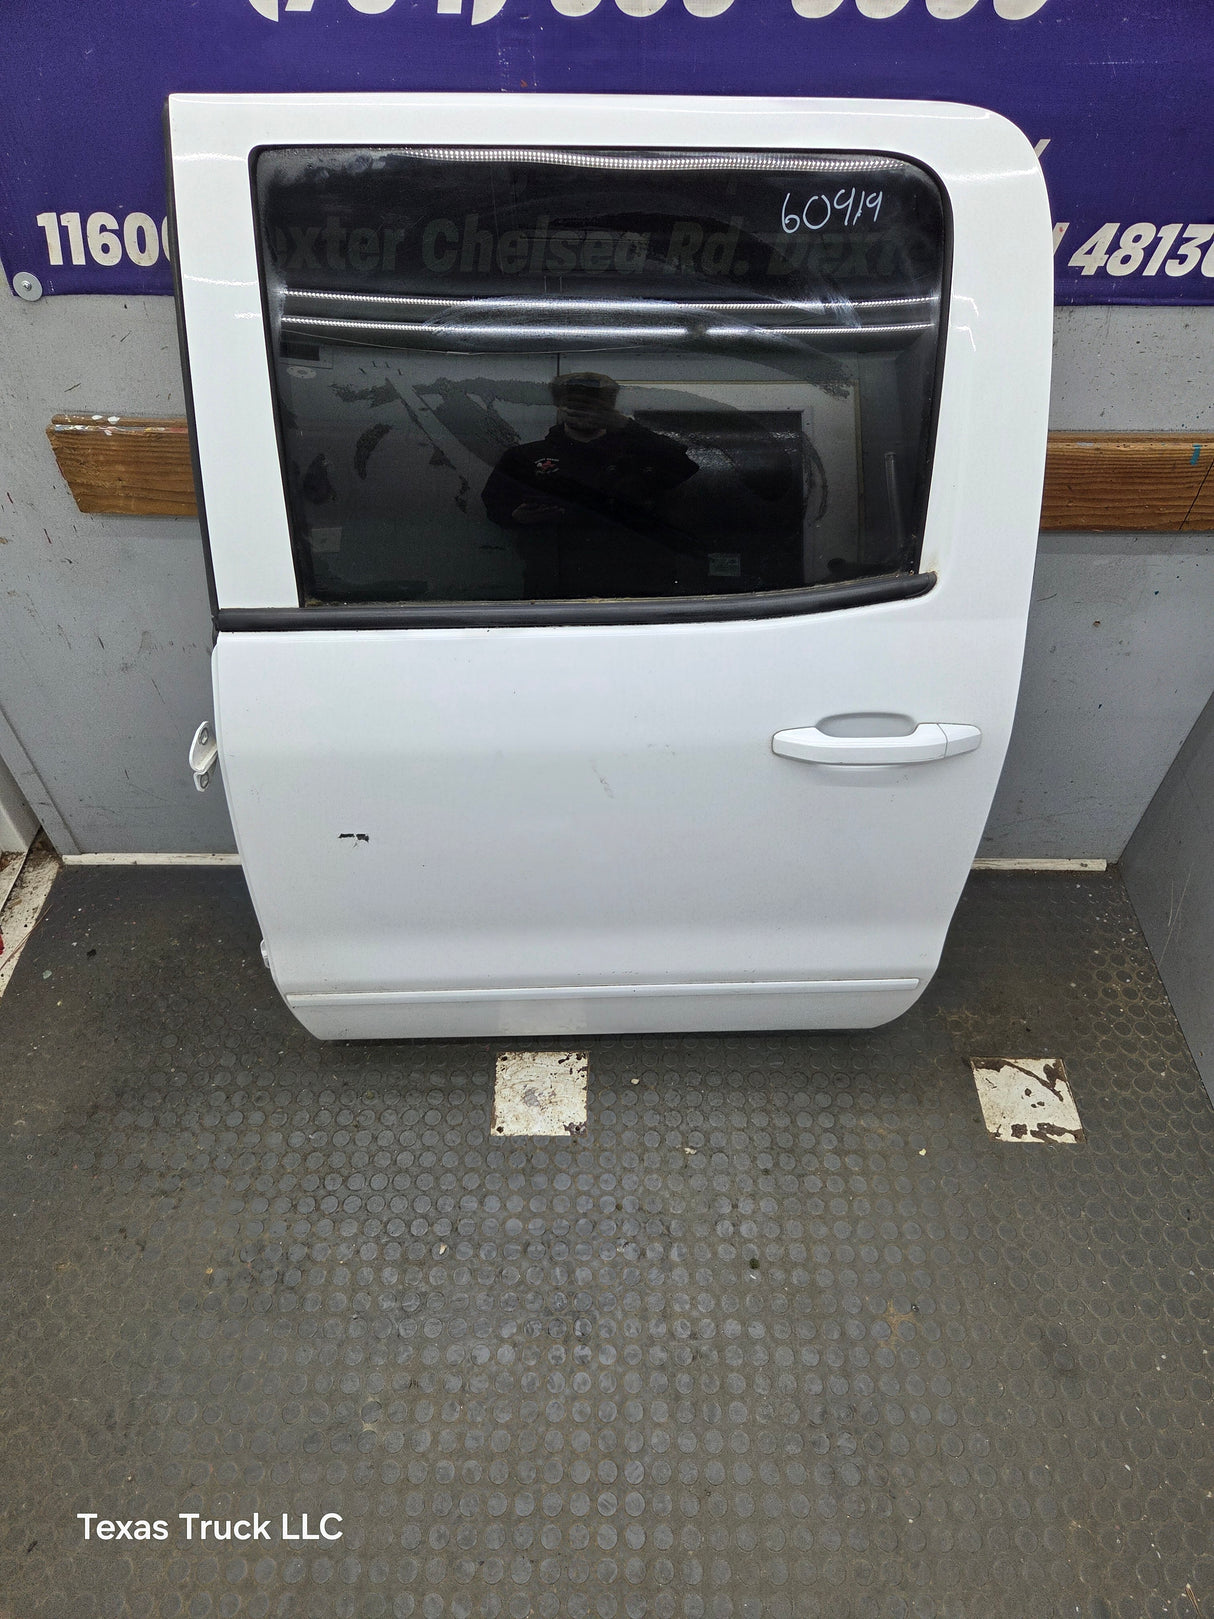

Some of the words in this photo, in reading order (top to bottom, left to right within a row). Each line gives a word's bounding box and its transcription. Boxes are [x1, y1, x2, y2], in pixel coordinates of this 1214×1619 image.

[36, 211, 171, 267] 1160
[422, 213, 650, 275] Chelsea
[663, 215, 750, 276] Rd.
